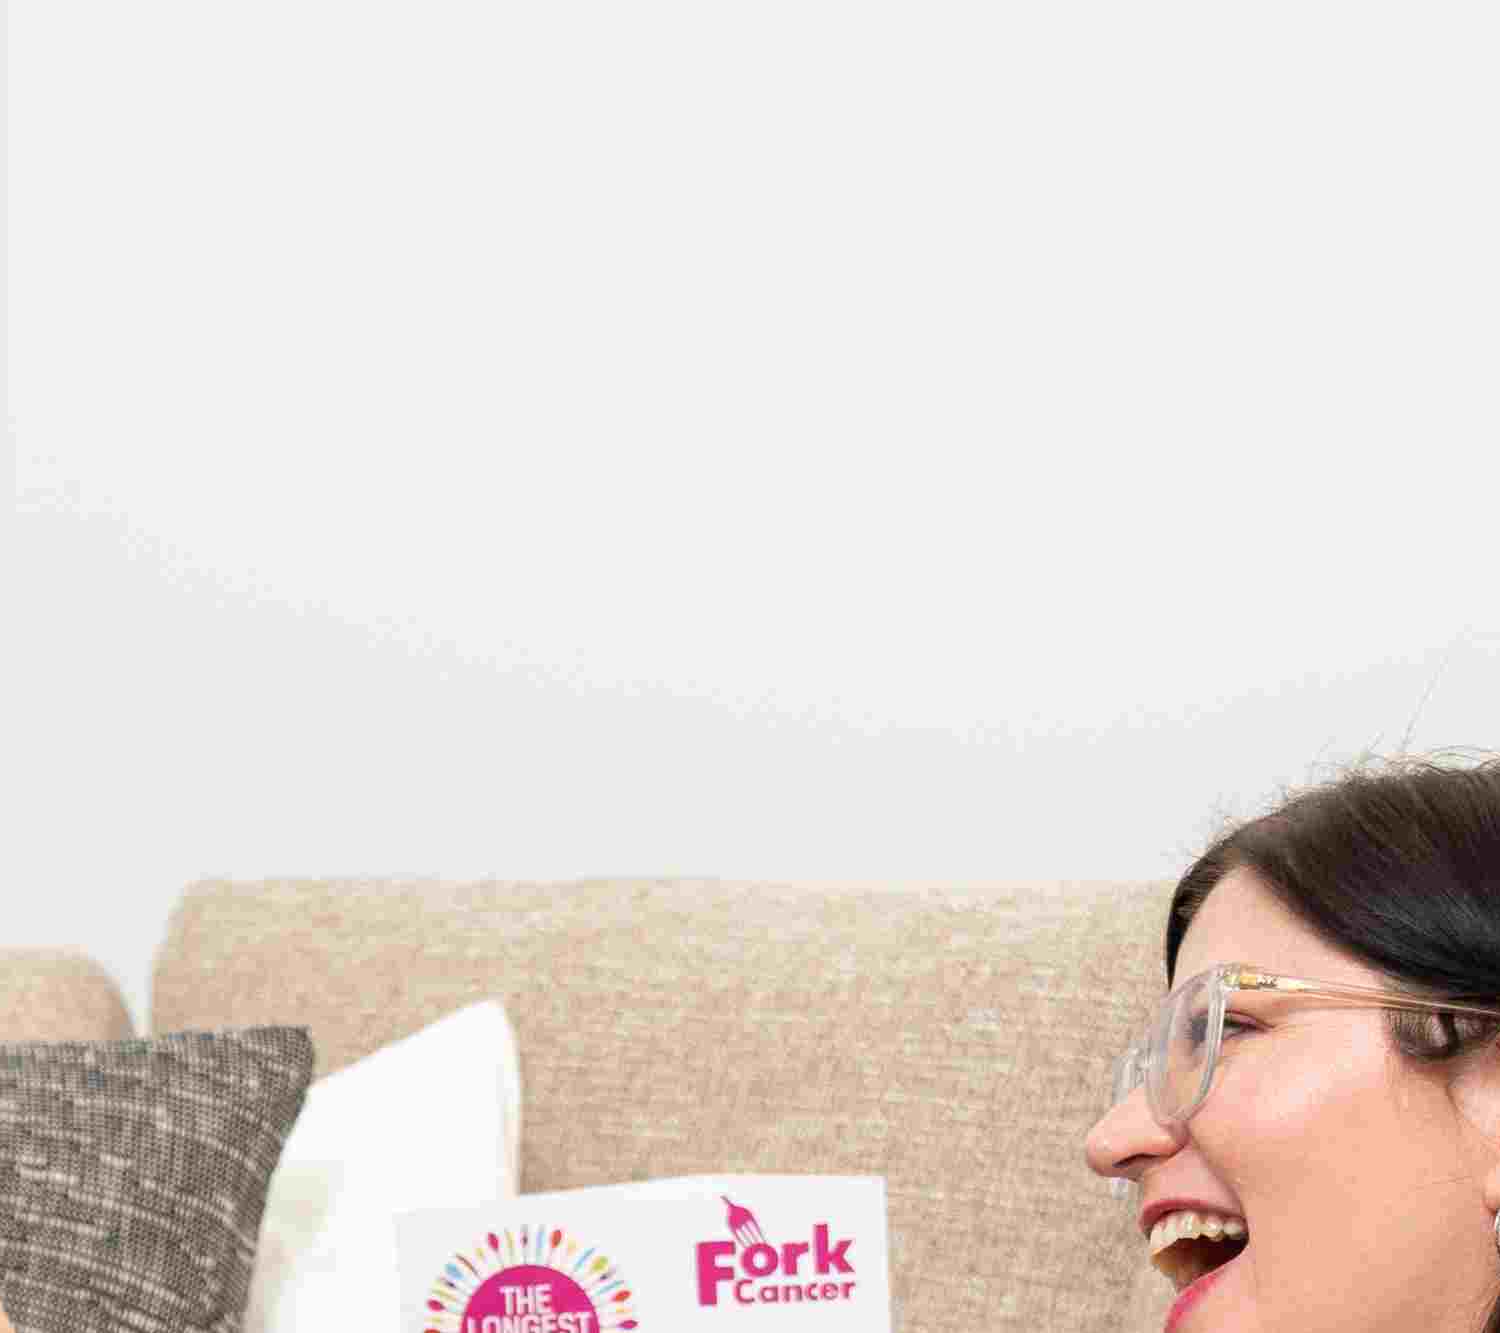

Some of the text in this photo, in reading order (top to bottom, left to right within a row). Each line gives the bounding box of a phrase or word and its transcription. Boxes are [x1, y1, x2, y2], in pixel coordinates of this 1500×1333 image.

[696, 1224, 856, 1306] Fork
[499, 1283, 552, 1315] THE
[734, 1280, 857, 1305] Cancer
